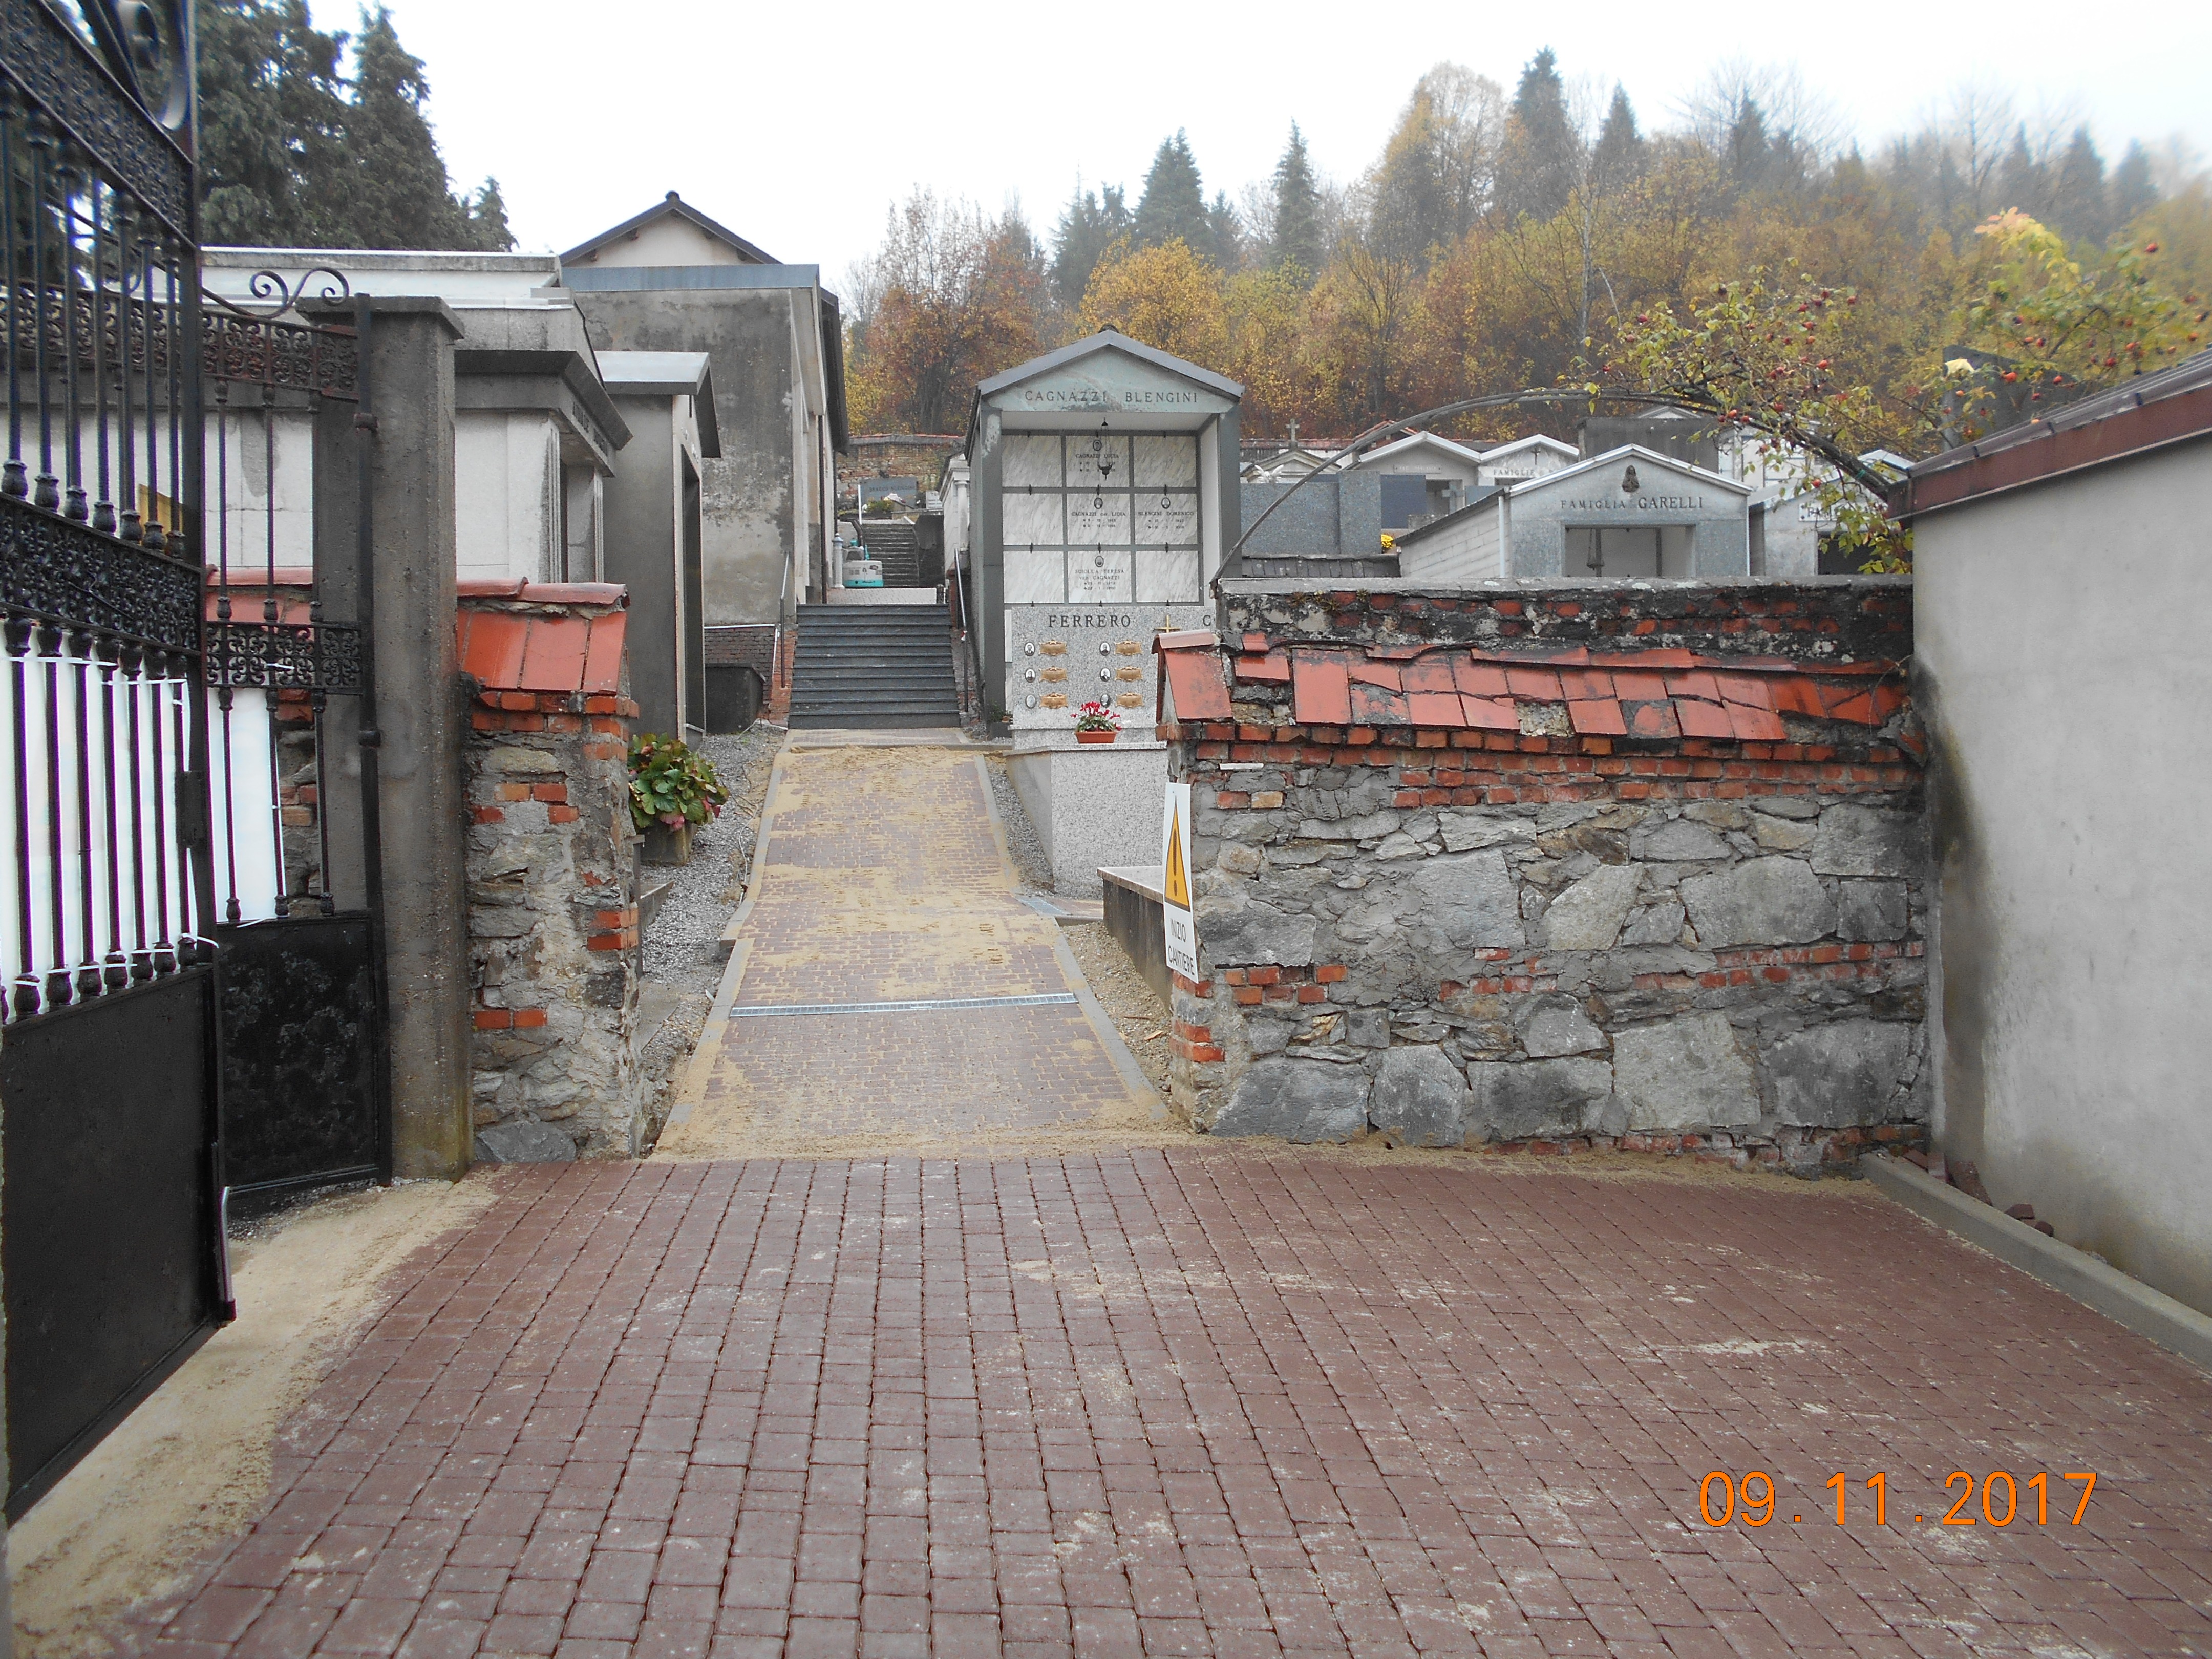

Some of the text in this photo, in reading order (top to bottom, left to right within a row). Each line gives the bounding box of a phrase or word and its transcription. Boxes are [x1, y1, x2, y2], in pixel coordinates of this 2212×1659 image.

[1025, 390, 1198, 403] CAGNAZZI BLENGINI
[1561, 497, 1703, 509] FAMIGLIA GARELLI
[1049, 615, 1131, 628] FERRERO
[1170, 917, 1186, 943] INIZIO
[1168, 944, 1195, 976] CANTIERE
